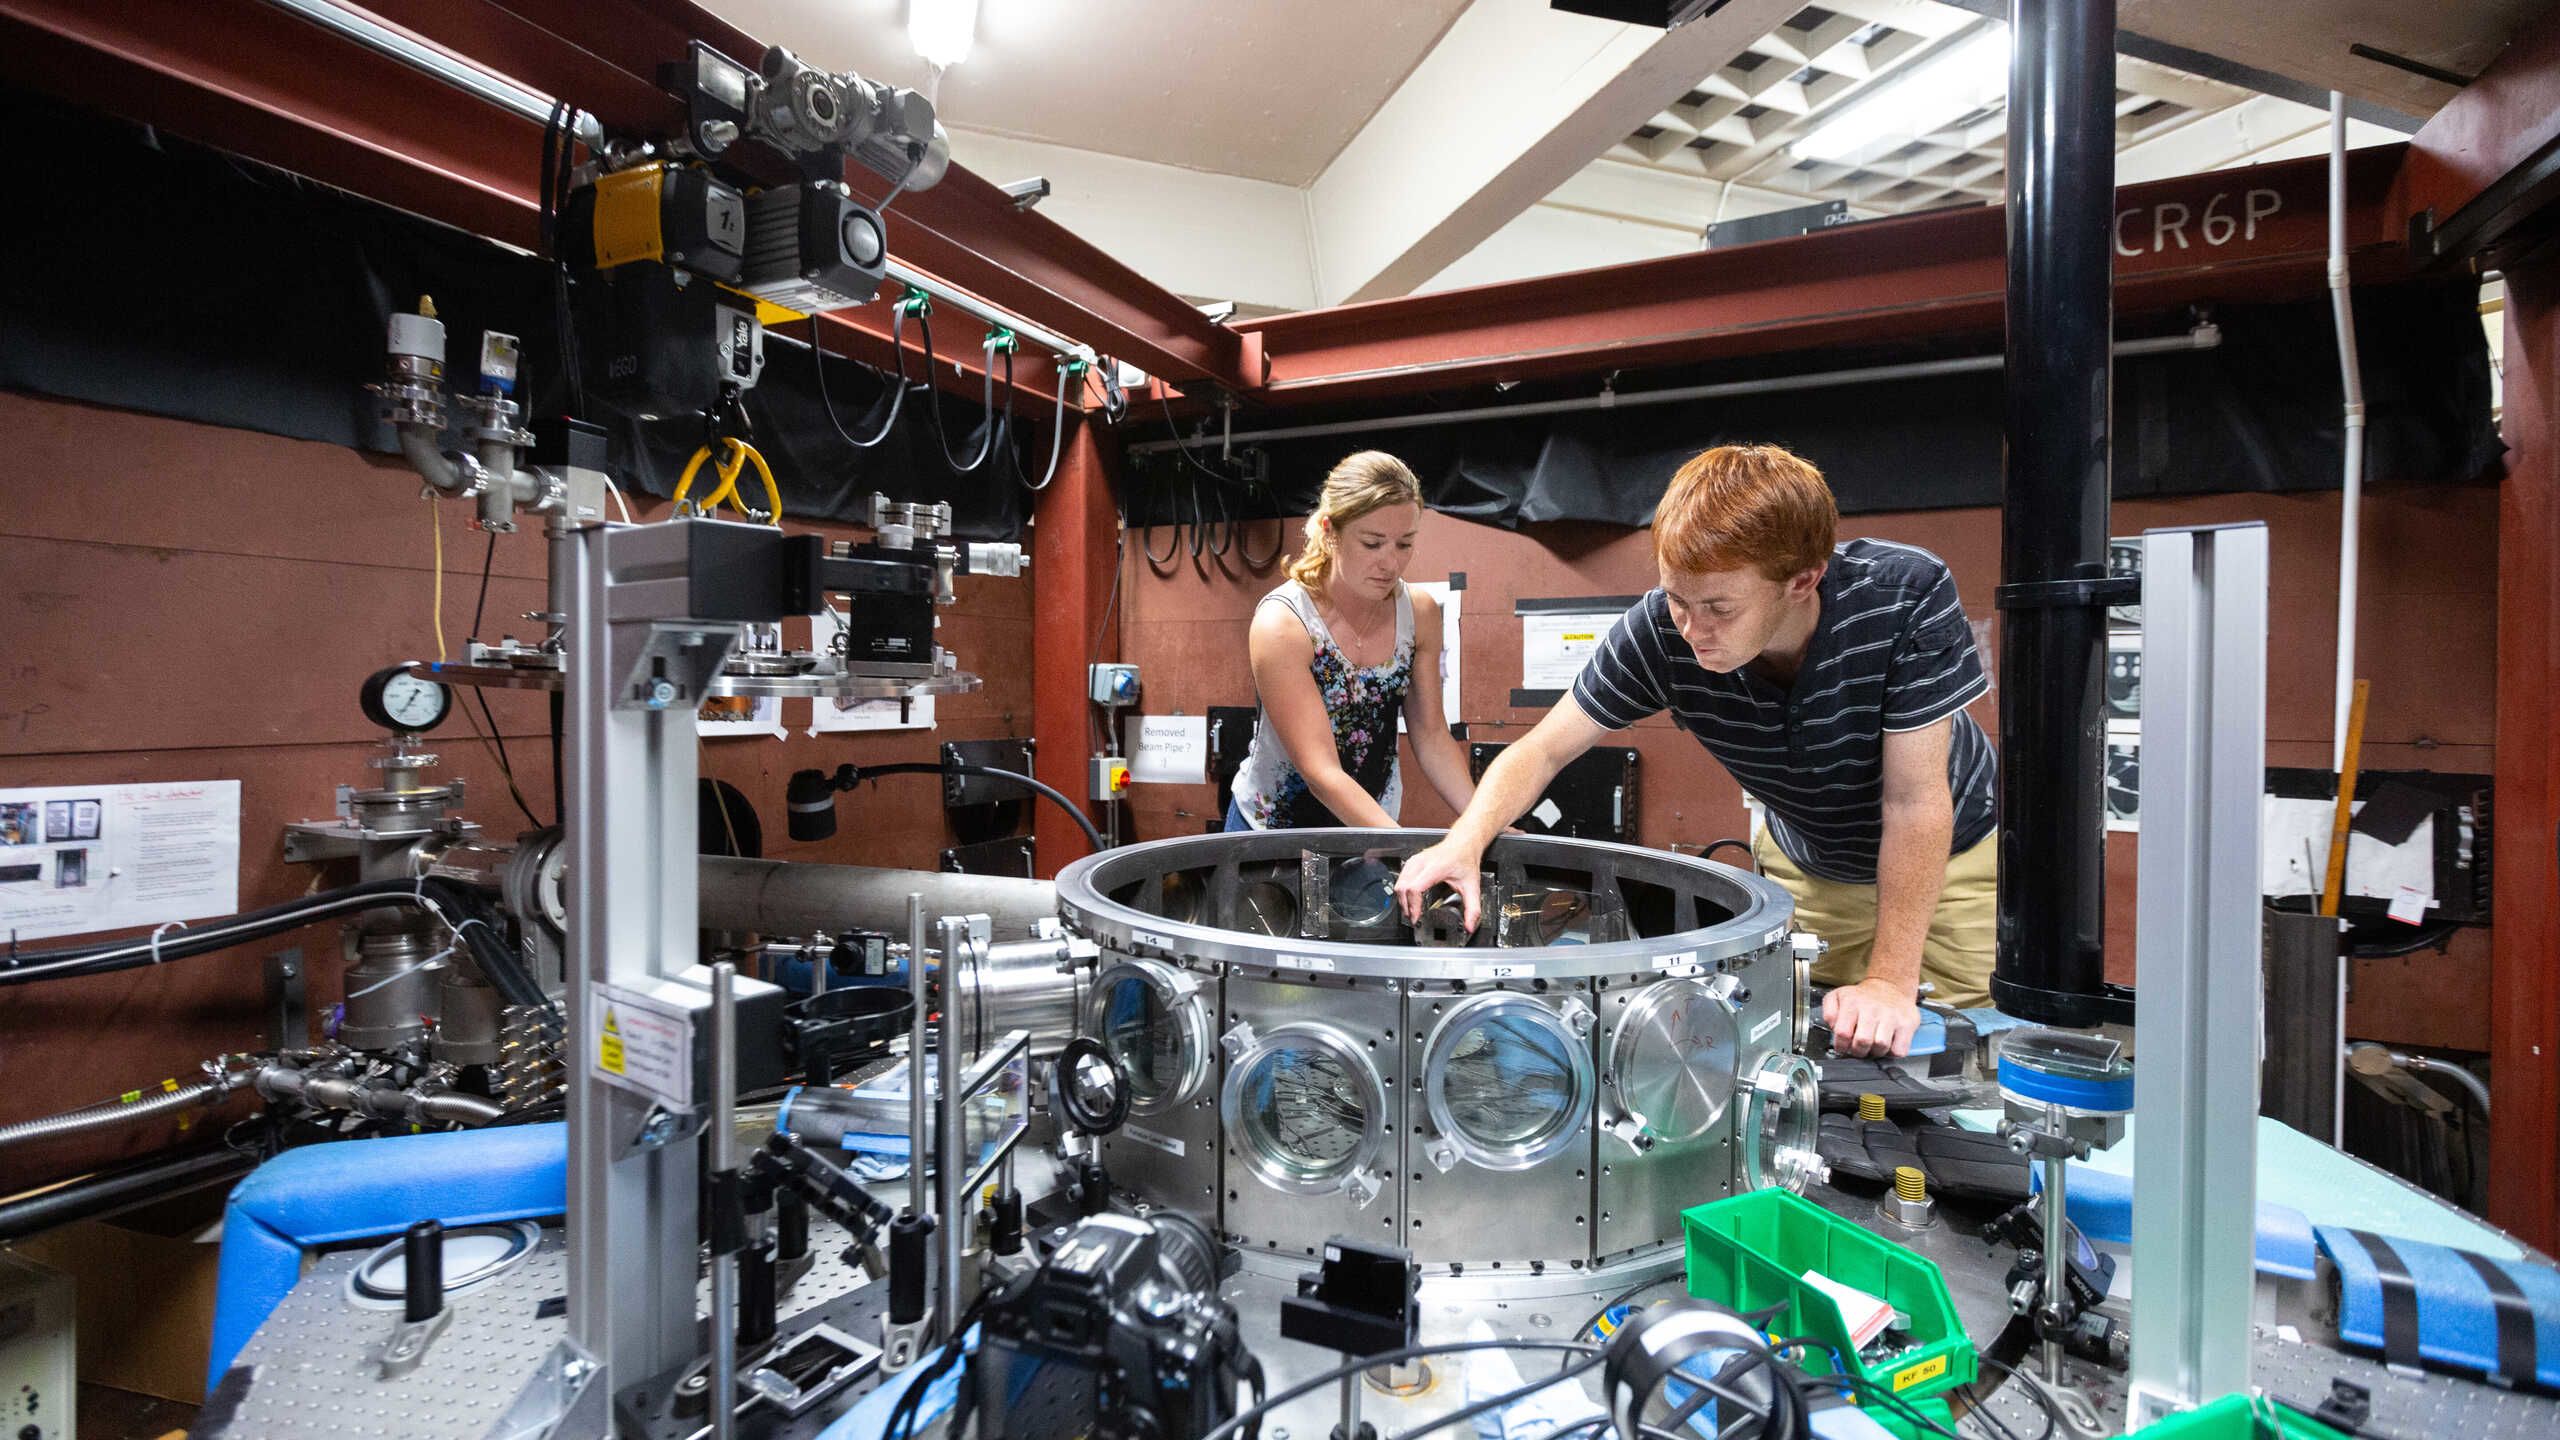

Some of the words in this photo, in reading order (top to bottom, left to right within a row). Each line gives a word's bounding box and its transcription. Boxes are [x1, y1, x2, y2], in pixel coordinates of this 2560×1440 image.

[2115, 188, 2283, 257] CR6P
[735, 320, 749, 349] Yale
[1144, 727, 1186, 737] Removed
[1138, 742, 1163, 752] Beam
[1164, 742, 1184, 753] Pipe
[1144, 935, 1158, 945] 14
[1669, 956, 1680, 966] 11
[1491, 967, 1513, 977] 12
[1903, 1371, 1917, 1383] KF
